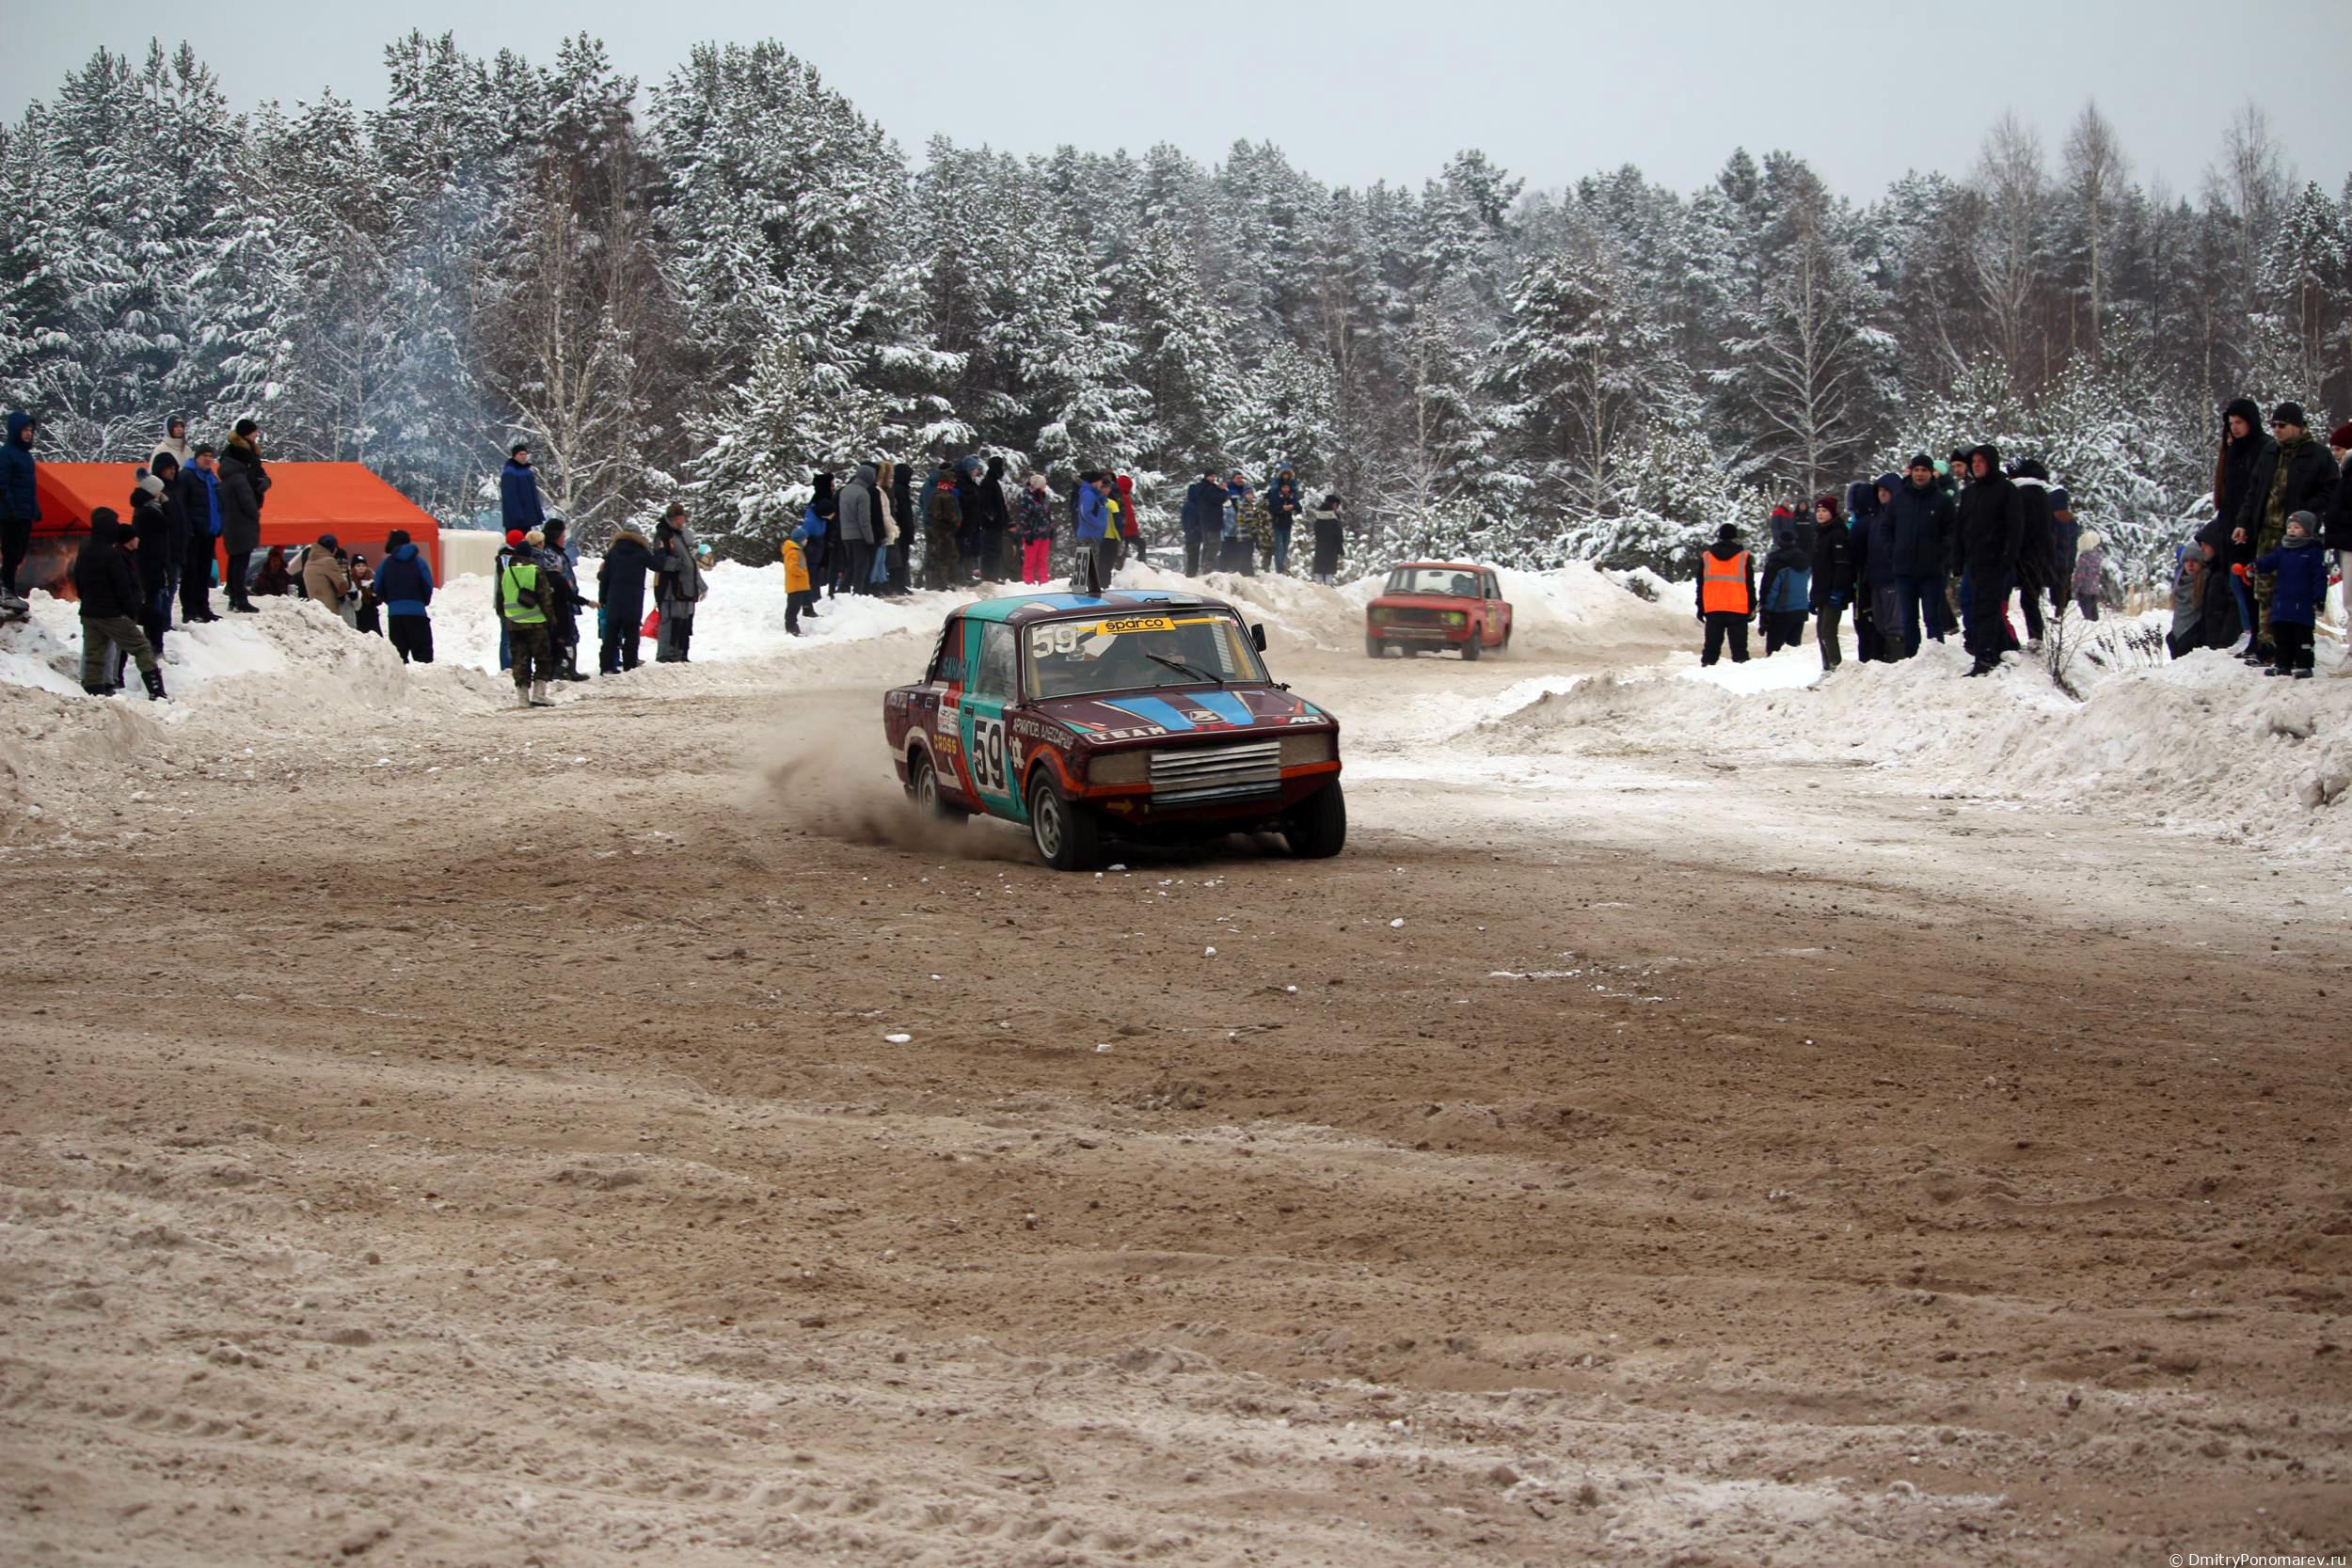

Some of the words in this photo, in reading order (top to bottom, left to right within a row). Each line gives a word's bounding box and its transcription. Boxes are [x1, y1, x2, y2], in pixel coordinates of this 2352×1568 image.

[1073, 551, 1088, 587] 59
[1105, 620, 1164, 632] sparco
[1032, 624, 1077, 658] 59
[933, 734, 957, 754] CROSS
[1091, 727, 1167, 741] TEAM
[974, 720, 1004, 789] 59
